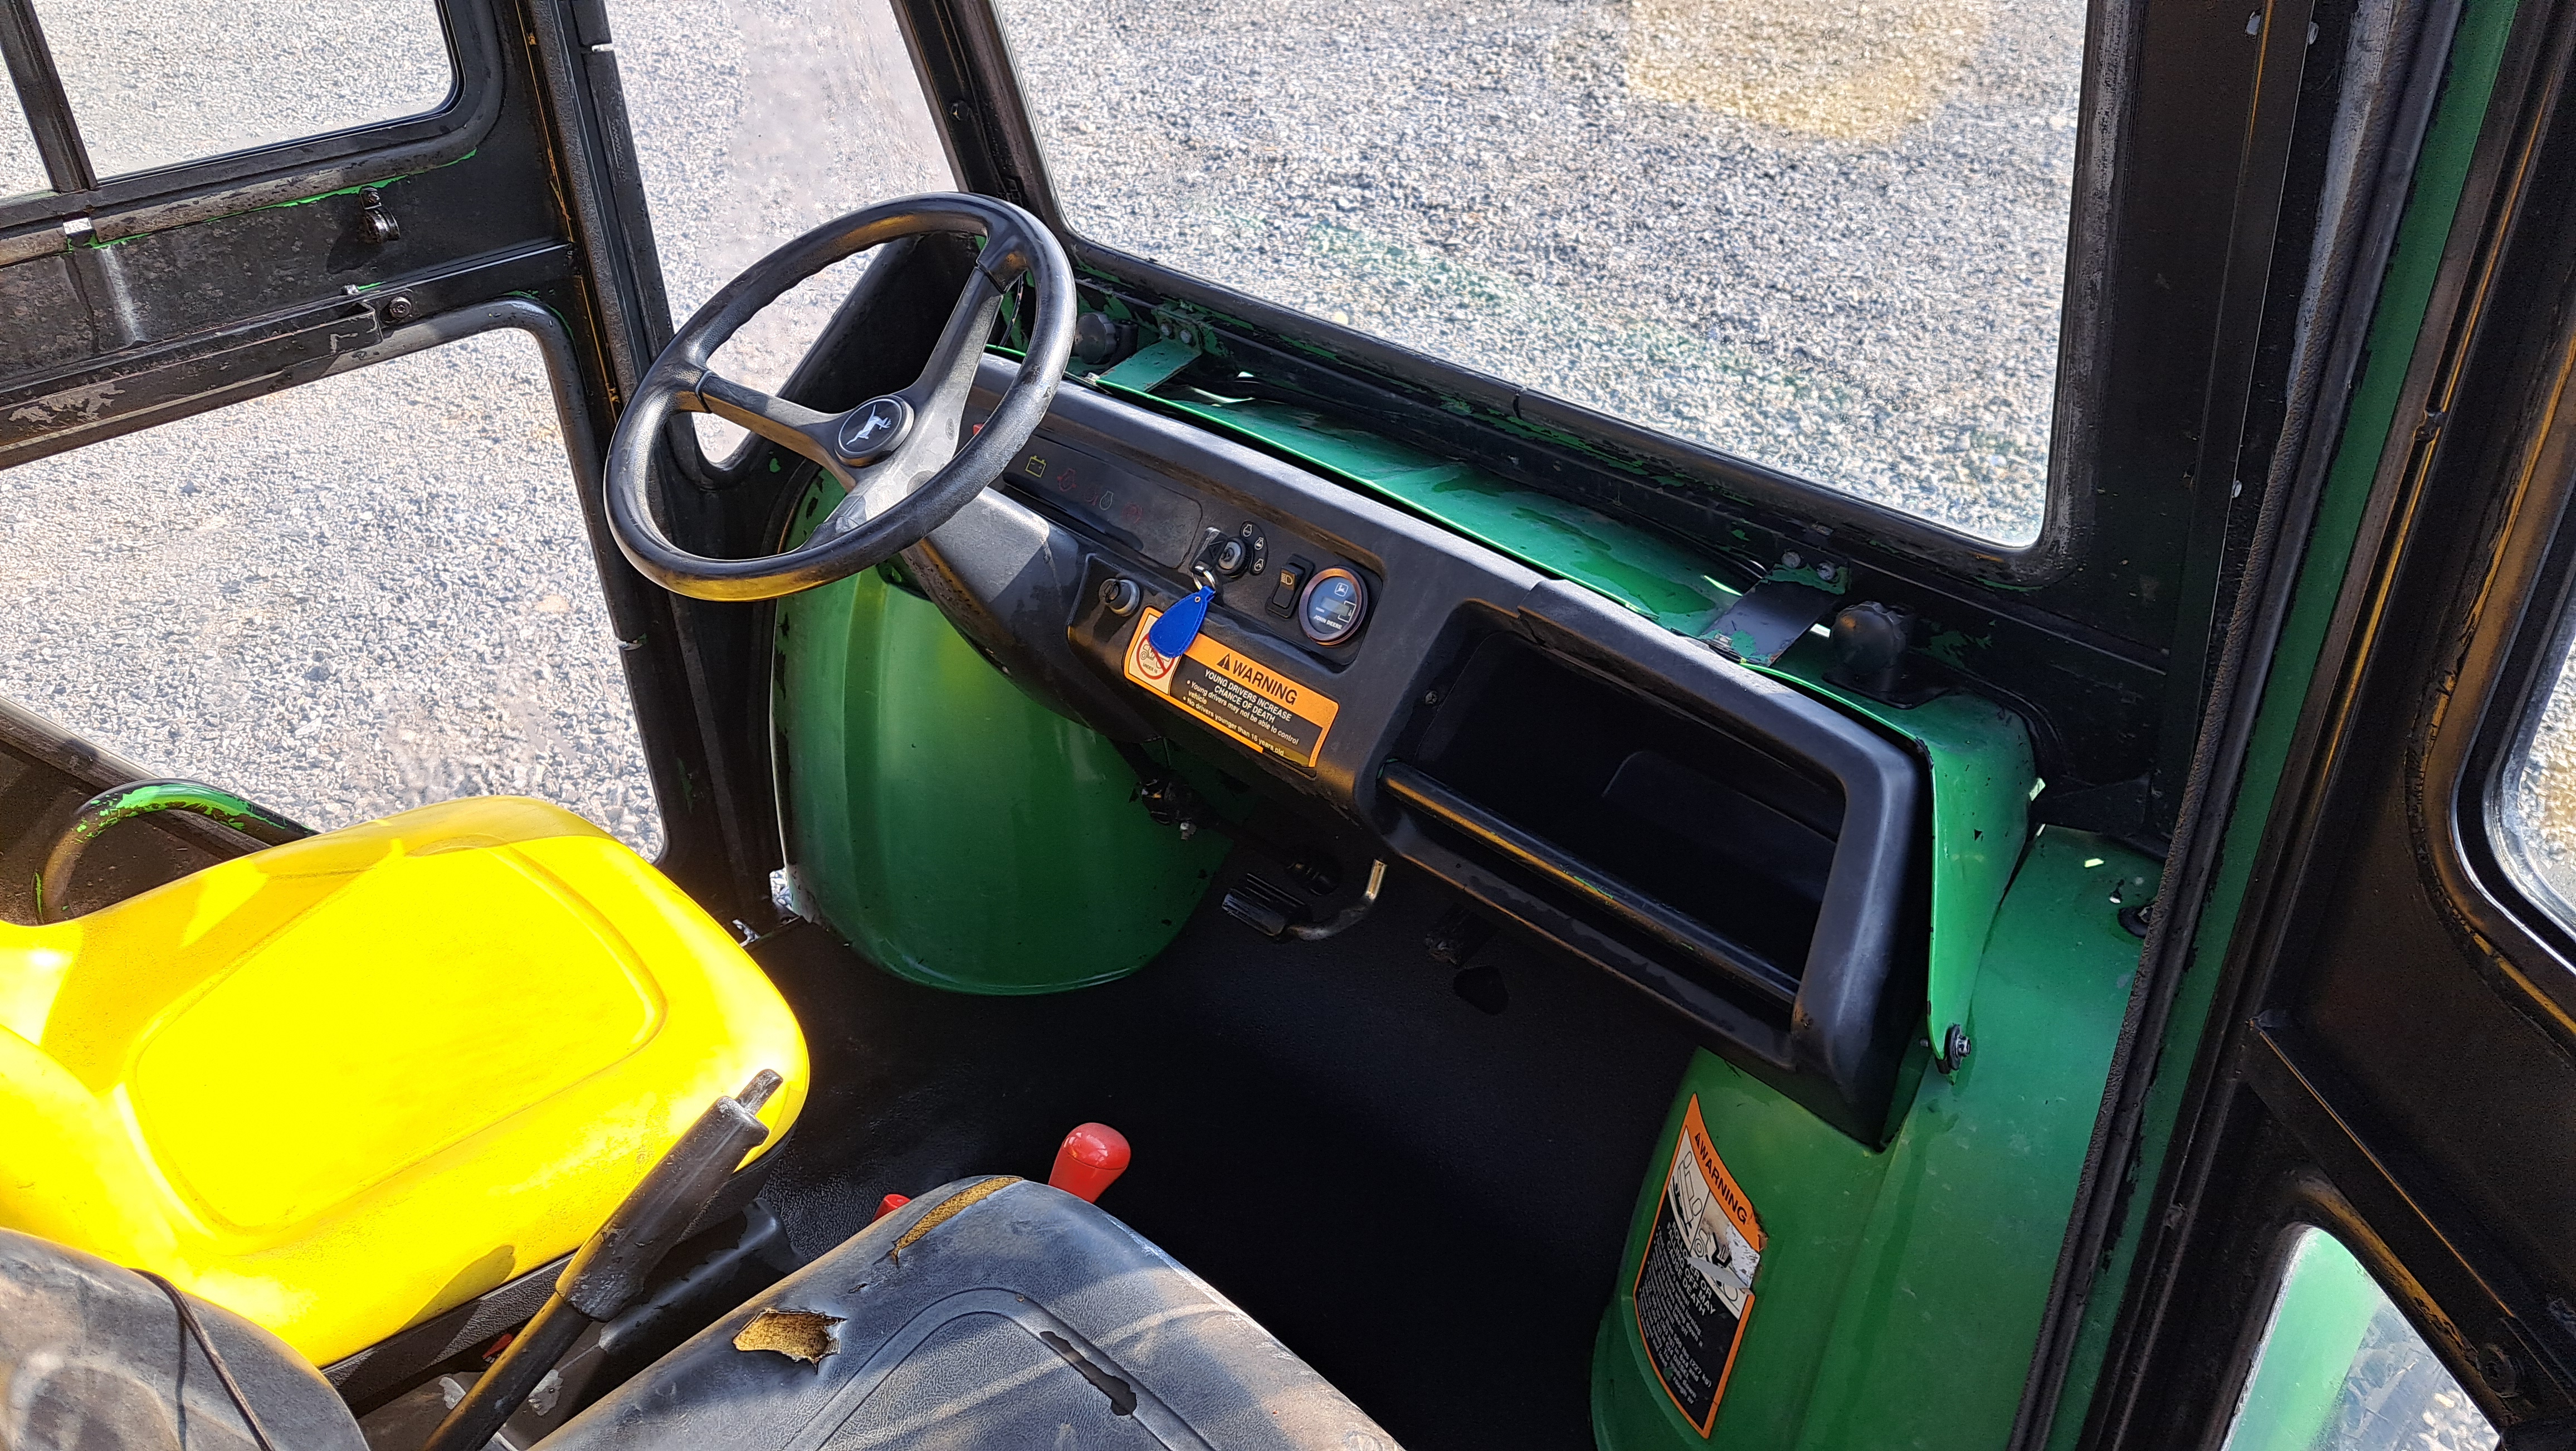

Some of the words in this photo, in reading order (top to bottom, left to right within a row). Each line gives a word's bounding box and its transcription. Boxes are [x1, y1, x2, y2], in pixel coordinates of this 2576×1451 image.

[1313, 615, 1326, 624] JOHN
[1326, 620, 1343, 630] DEERE
[1188, 690, 1207, 705] vehicle
[1204, 669, 1228, 687] YOUNG
[1228, 680, 1256, 703] DRIVERS
[1257, 695, 1292, 722] INCREASE
[1233, 659, 1297, 705] WARNING
[1191, 680, 1208, 695] Young
[1208, 690, 1226, 706] drivers
[1227, 700, 1240, 714] may
[1240, 708, 1250, 718] not
[1250, 714, 1257, 723] be
[1258, 719, 1270, 730] able
[1271, 725, 1277, 734] to
[1278, 730, 1299, 745] control
[1214, 685, 1241, 705] CHANCE
[1242, 700, 1252, 710] OF
[1252, 705, 1276, 724] DEATH
[1187, 698, 1195, 706] No
[1196, 702, 1213, 717] drivers
[1215, 713, 1237, 731] younger
[1237, 725, 1250, 737] than
[1251, 733, 1258, 742] 16
[1258, 738, 1274, 752] years
[1275, 746, 1284, 756] old
[1700, 1140, 1747, 1225] WARNING
[1667, 1222, 1685, 1269] FALLING
[1685, 1268, 1699, 1289] OFF
[1699, 1289, 1716, 1314] MAY
[1667, 1241, 1682, 1279] CAUSE
[1682, 1280, 1705, 1316] DEATH
[1701, 1280, 1712, 1298] OR
[1675, 1280, 1690, 1308] manual.
[1675, 1291, 1685, 1311] when
[1685, 1309, 1701, 1336] turning.
[1672, 1308, 1688, 1336] take-off
[1674, 1303, 1686, 1323] going
[1686, 1322, 1698, 1341] down
[1665, 1318, 1674, 1335] than
[1673, 1333, 1682, 1348] 500
[1701, 1374, 1711, 1387] kg)
[1679, 1353, 1689, 1368] 6x4
[1688, 1367, 1699, 1381] and
[1672, 1376, 1687, 1396] rough
